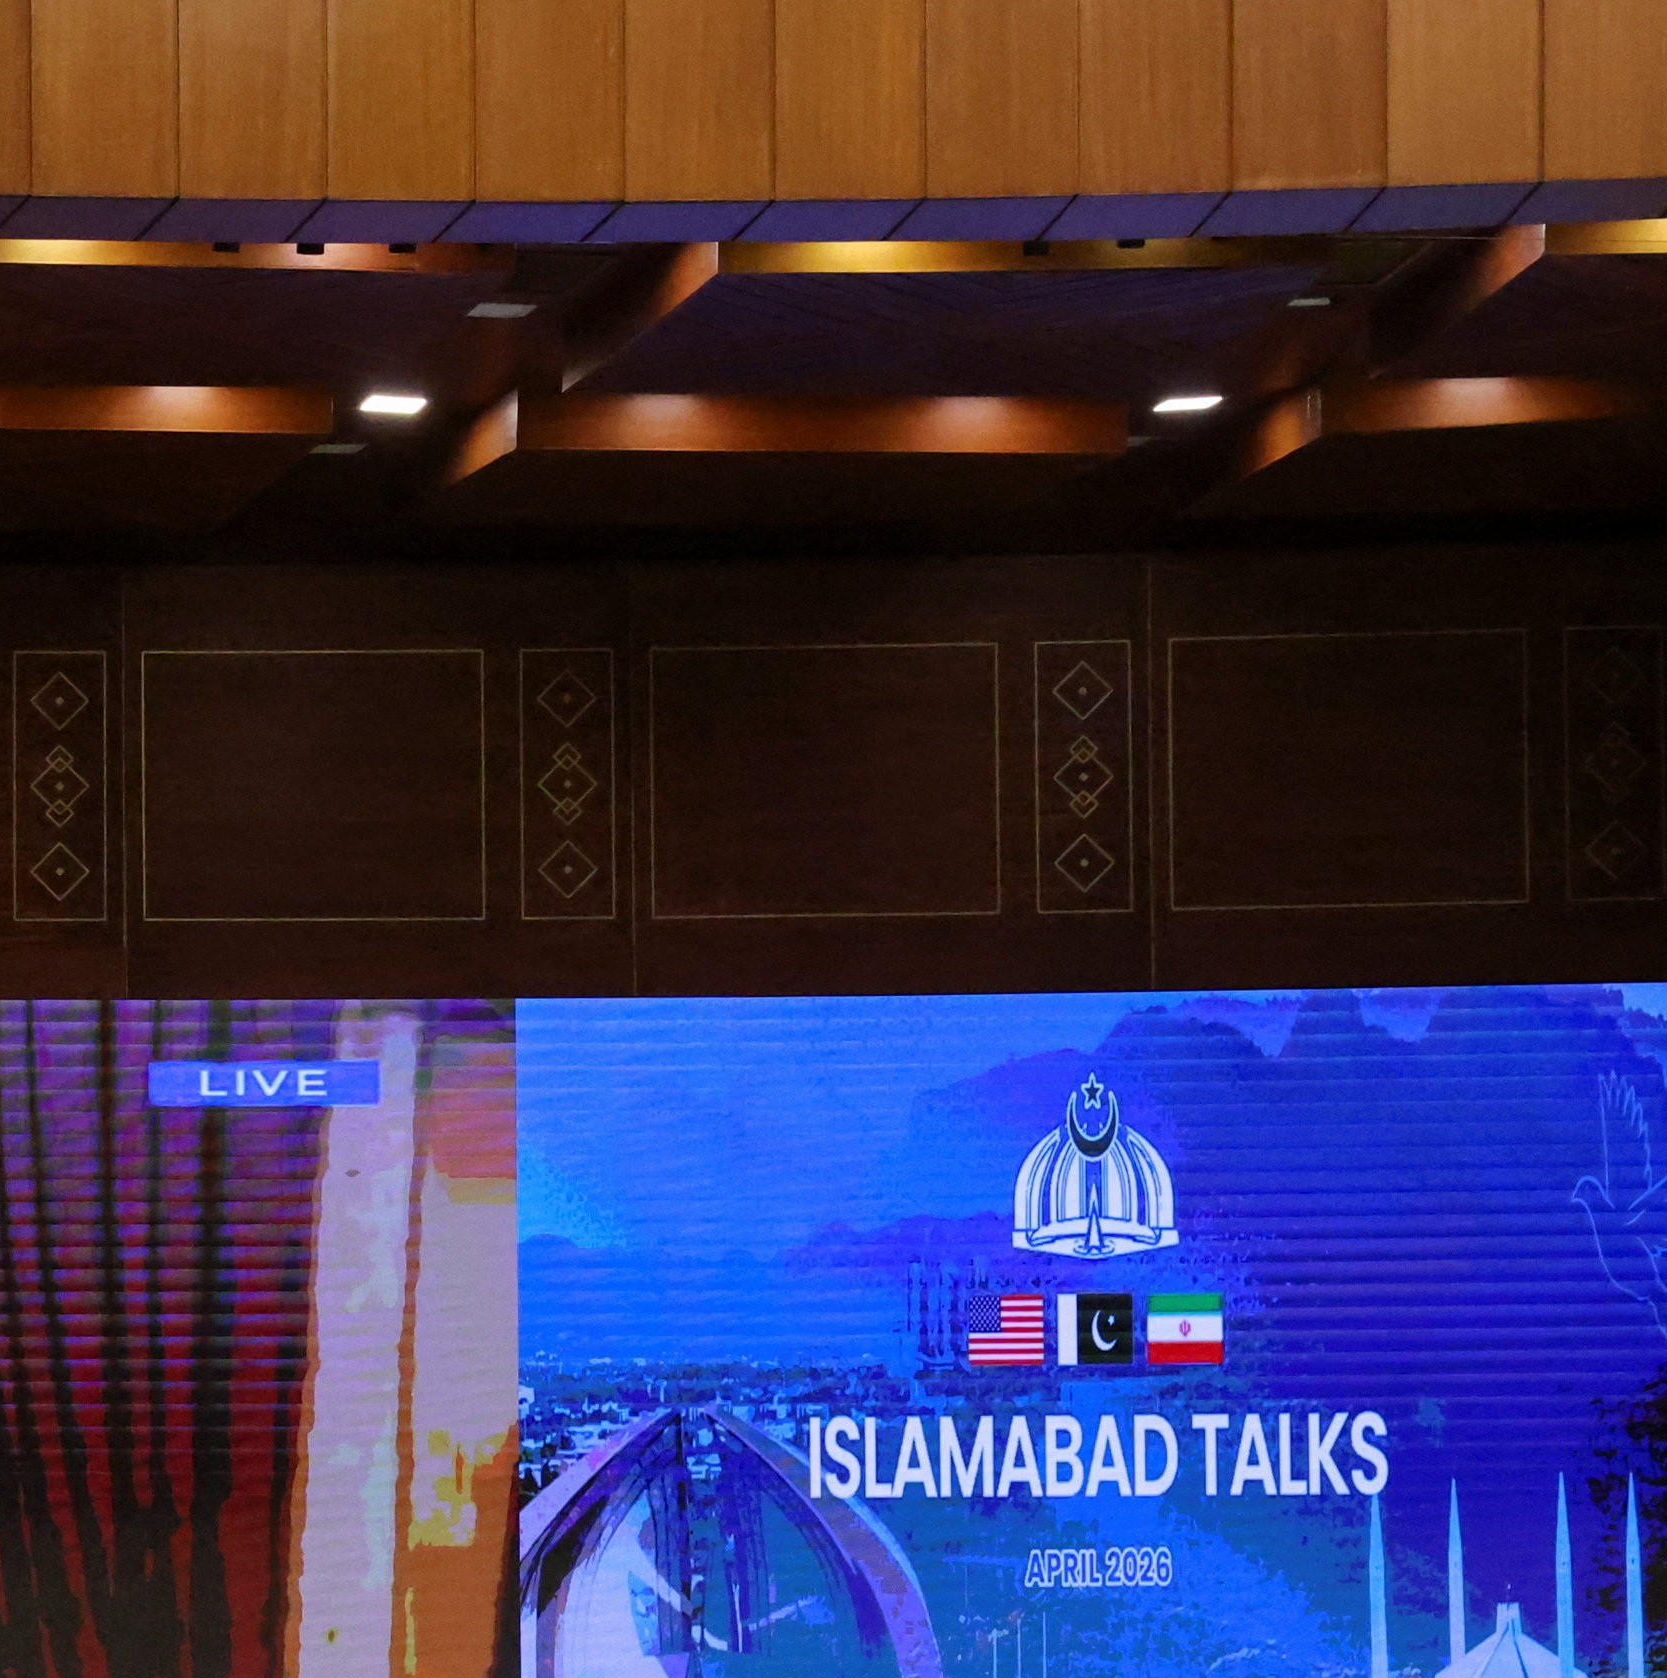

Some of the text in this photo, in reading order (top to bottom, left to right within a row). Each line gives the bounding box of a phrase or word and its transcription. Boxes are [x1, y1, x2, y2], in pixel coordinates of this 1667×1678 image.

[199, 1069, 328, 1097] LIVE
[808, 1410, 1390, 1499] ISLAMABAD TALKS
[1024, 1547, 1172, 1587] APRIL 2026
